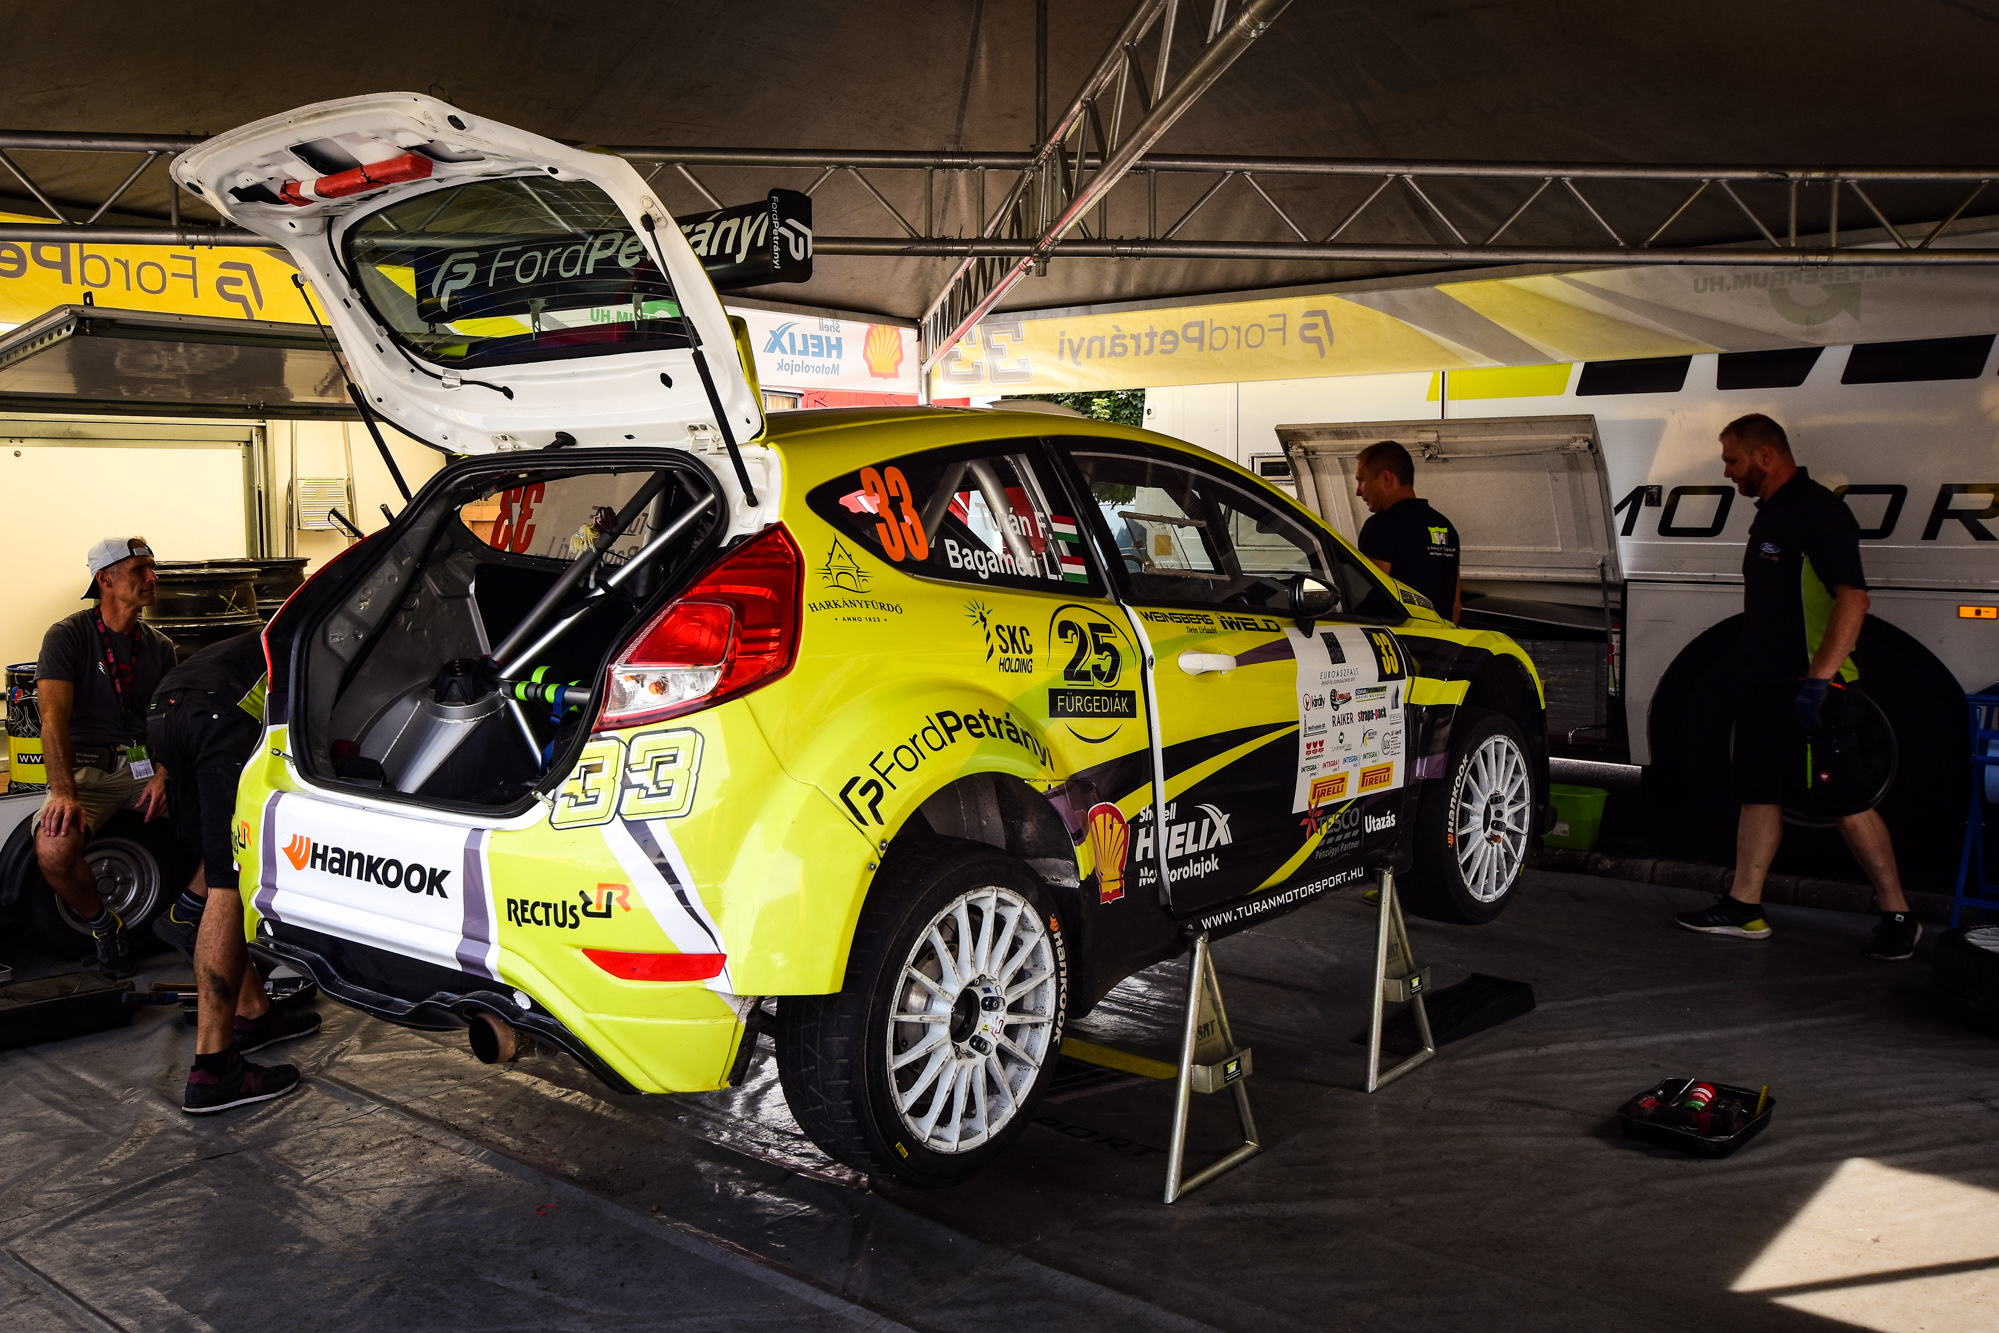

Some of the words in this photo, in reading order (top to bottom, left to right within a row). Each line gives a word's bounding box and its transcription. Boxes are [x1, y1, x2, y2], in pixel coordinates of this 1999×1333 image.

[859, 466, 929, 562] 33
[944, 539, 1041, 580] Bagaméri
[842, 615, 863, 623] ANNO
[865, 615, 881, 624] 1823
[1139, 610, 1214, 625] WEINSBERG
[995, 624, 1033, 655] SKC
[1057, 619, 1123, 688] 25
[1372, 632, 1399, 675] 33
[998, 657, 1033, 674] HOLDING
[1319, 667, 1360, 680] EUROASZFALT
[1056, 691, 1130, 713] FÜRGEDIÁK
[868, 708, 1056, 791] FordPetrányi
[550, 727, 705, 831] 33
[1311, 777, 1346, 800] PIRELLI
[1360, 766, 1391, 788] PIRELLI
[1447, 753, 1470, 834] Hankook
[1316, 807, 1360, 837] TESCO
[1364, 810, 1397, 834] Utazás
[310, 841, 452, 900] Hankook
[1201, 866, 1365, 929] WWW.TURANMOTORSPORT.HU
[506, 898, 580, 930] RECTUS
[1052, 930, 1070, 1047] Hankook
